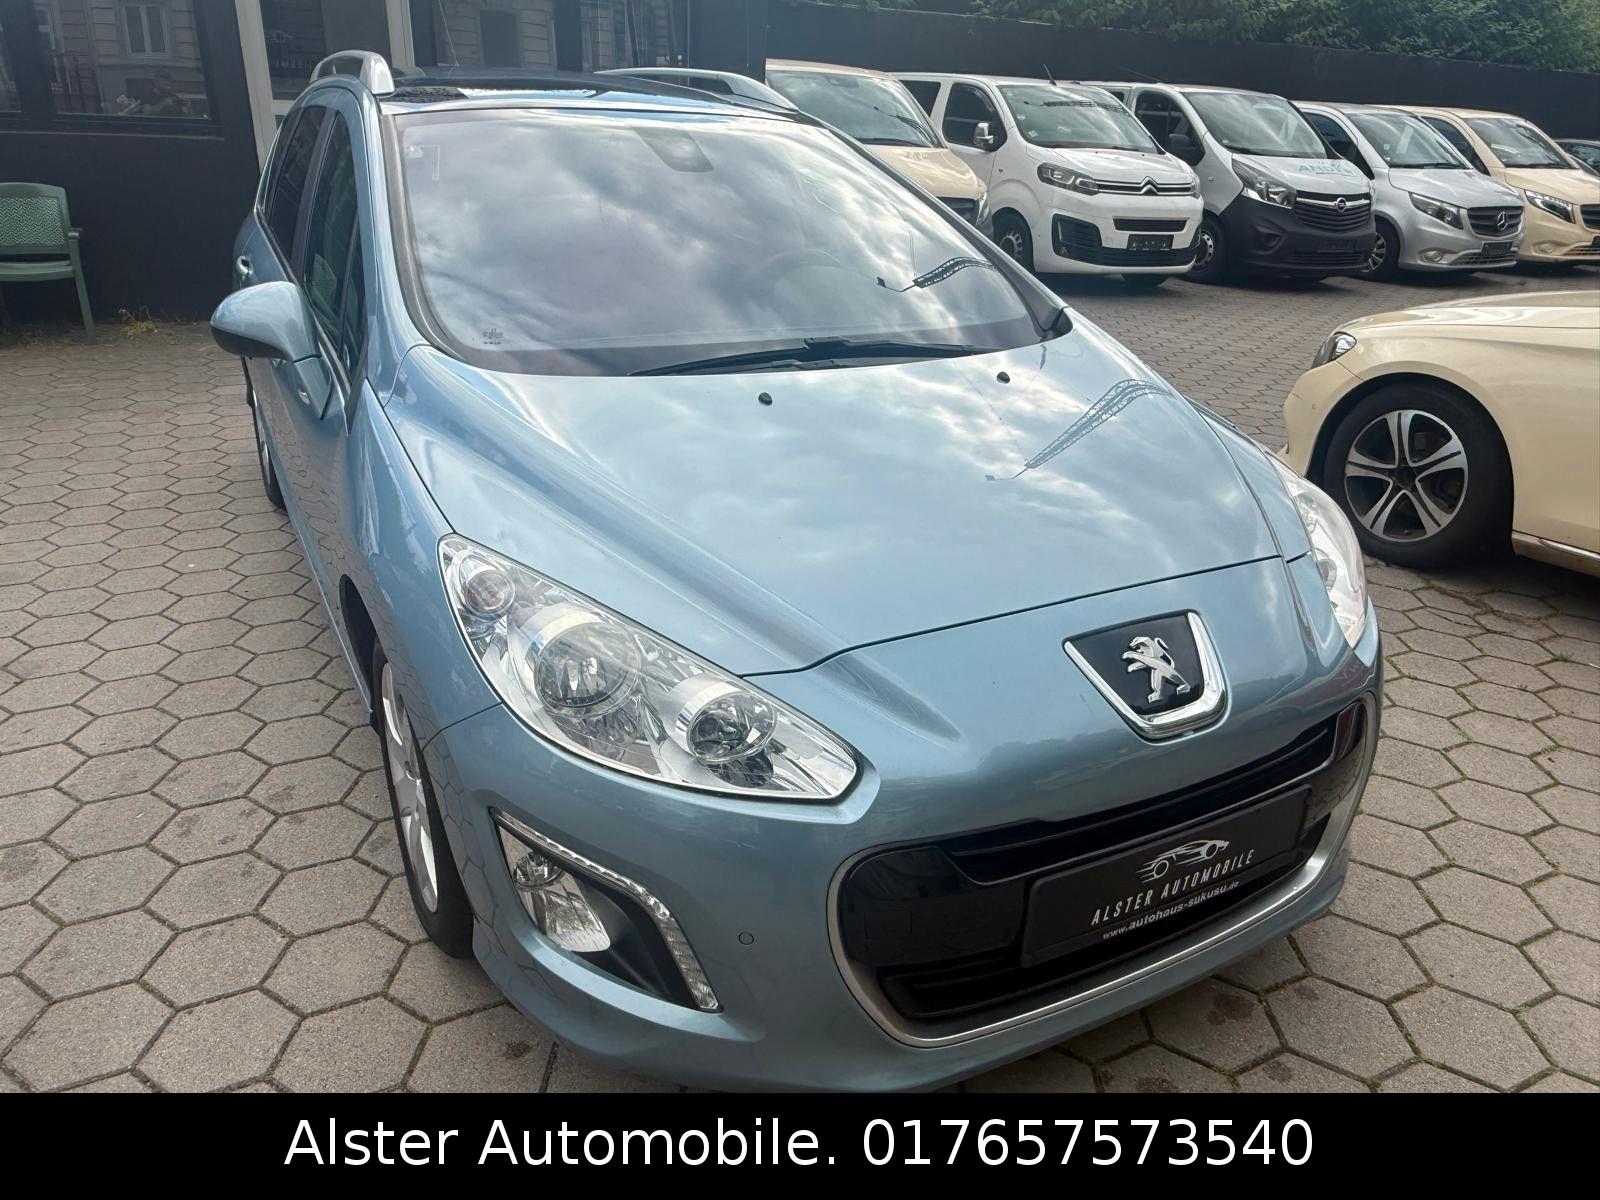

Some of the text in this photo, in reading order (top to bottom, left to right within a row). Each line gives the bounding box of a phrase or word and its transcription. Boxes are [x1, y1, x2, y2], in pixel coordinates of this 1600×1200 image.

[1091, 849, 1255, 926] ALSTER AUTOMOBILE
[1102, 881, 1240, 940] www.autohaus-sukusu.de
